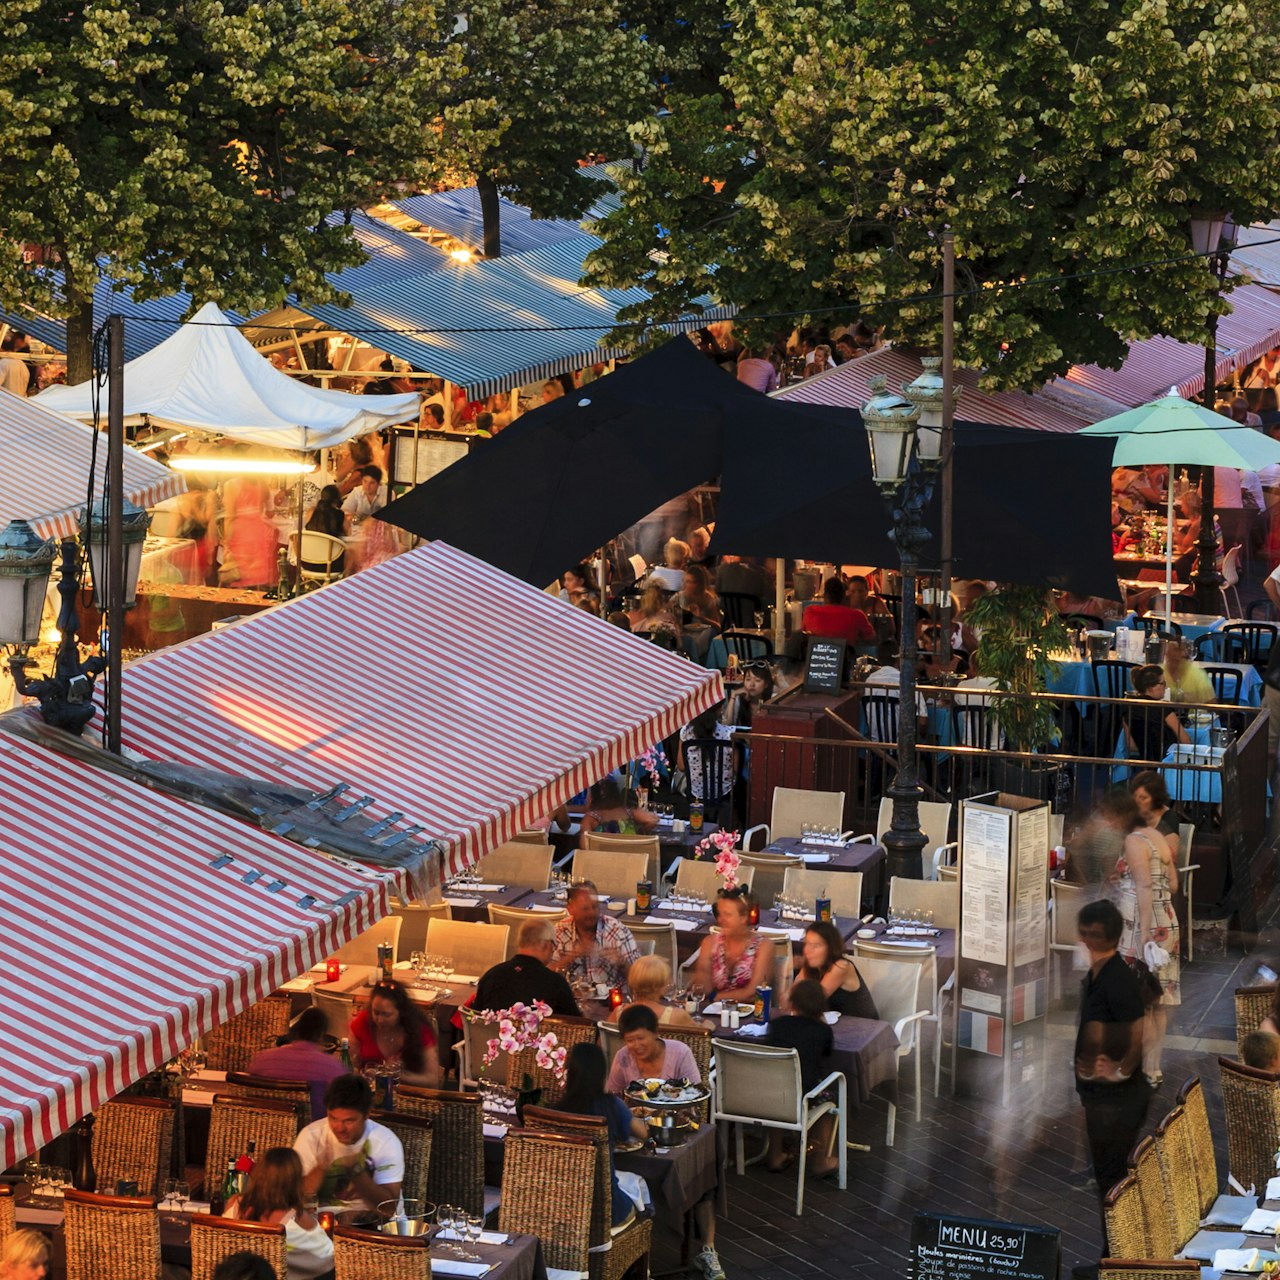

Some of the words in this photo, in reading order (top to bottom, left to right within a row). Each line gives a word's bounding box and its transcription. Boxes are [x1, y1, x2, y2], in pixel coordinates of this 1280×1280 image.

[941, 1225, 987, 1249] MENU
[918, 1245, 944, 1258] Moules
[945, 1252, 984, 1263] marinières
[917, 1263, 945, 1276] Salade
[918, 1255, 944, 1270] Soupe
[946, 1259, 955, 1268] de
[957, 1263, 986, 1272] poissons
[986, 1266, 995, 1274] de
[1018, 1271, 1045, 1280] maison
